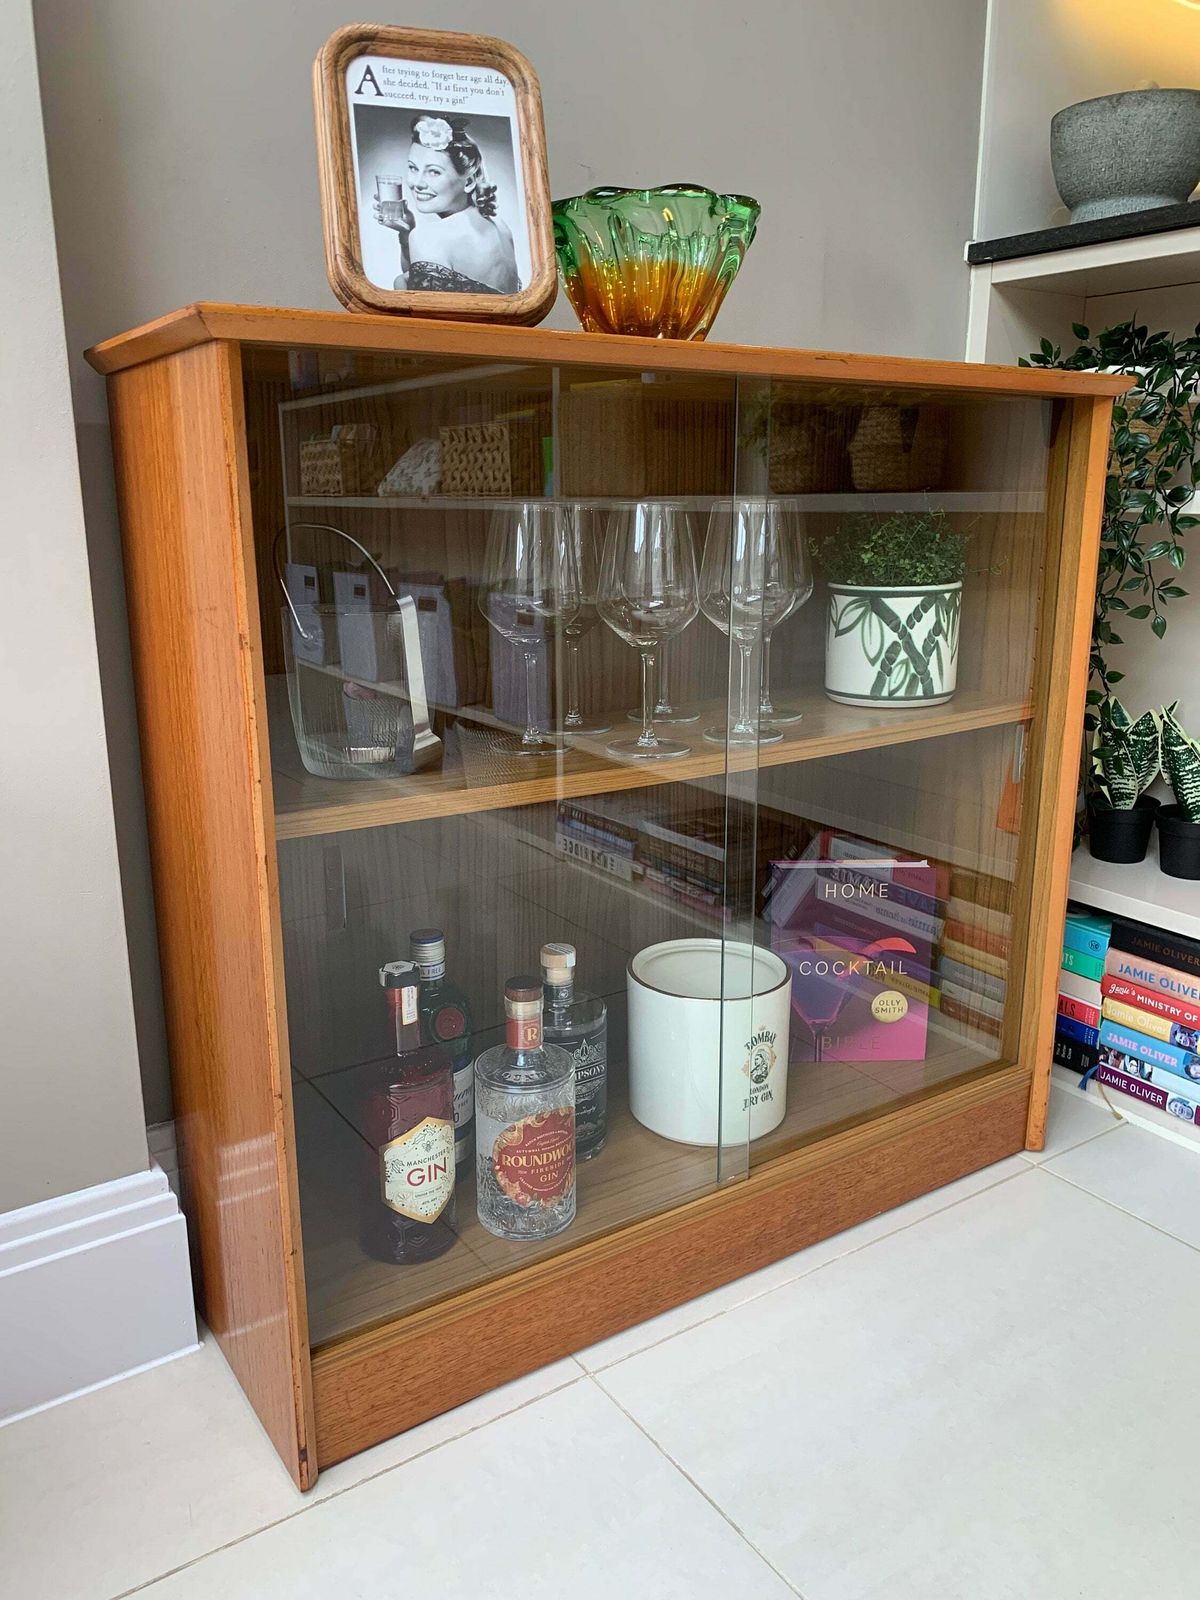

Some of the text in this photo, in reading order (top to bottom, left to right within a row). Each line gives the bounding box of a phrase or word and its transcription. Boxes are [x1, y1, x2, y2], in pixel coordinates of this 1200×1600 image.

[397, 69, 421, 79] trying
[421, 70, 430, 78] to
[431, 69, 454, 82] forget
[456, 72, 468, 81] her
[470, 76, 482, 84] age
[484, 75, 493, 83] all
[383, 78, 397, 87] she
[452, 83, 468, 93] first
[470, 87, 484, 96] you
[433, 95, 444, 105] try
[825, 883, 889, 899] HOME
[1130, 937, 1200, 967] JAMIE OLIVER
[799, 960, 908, 977] COCKTAIL
[1118, 963, 1156, 984] JAMIE
[1159, 977, 1200, 1000] OLIVE
[875, 1006, 904, 1014] SMITH
[1108, 983, 1199, 1023] Jamie's MINISTRY OF
[1108, 1003, 1134, 1021] Jamie
[1136, 1016, 1168, 1035] Oliver
[527, 1027, 538, 1041] R
[744, 1031, 777, 1050] BOMBAY
[1107, 1032, 1138, 1052] JAMIE
[1140, 1045, 1179, 1068] OLIVER
[575, 1064, 605, 1080] PSONS
[750, 1083, 769, 1095] LONDON
[760, 1089, 774, 1102] GIN
[1100, 1071, 1164, 1105] JAMIE OLIVER
[407, 1148, 446, 1167] MANCHESTER
[406, 1156, 448, 1188] GIN
[530, 1159, 565, 1175] FIRESIDE
[540, 1170, 559, 1183] GIN
